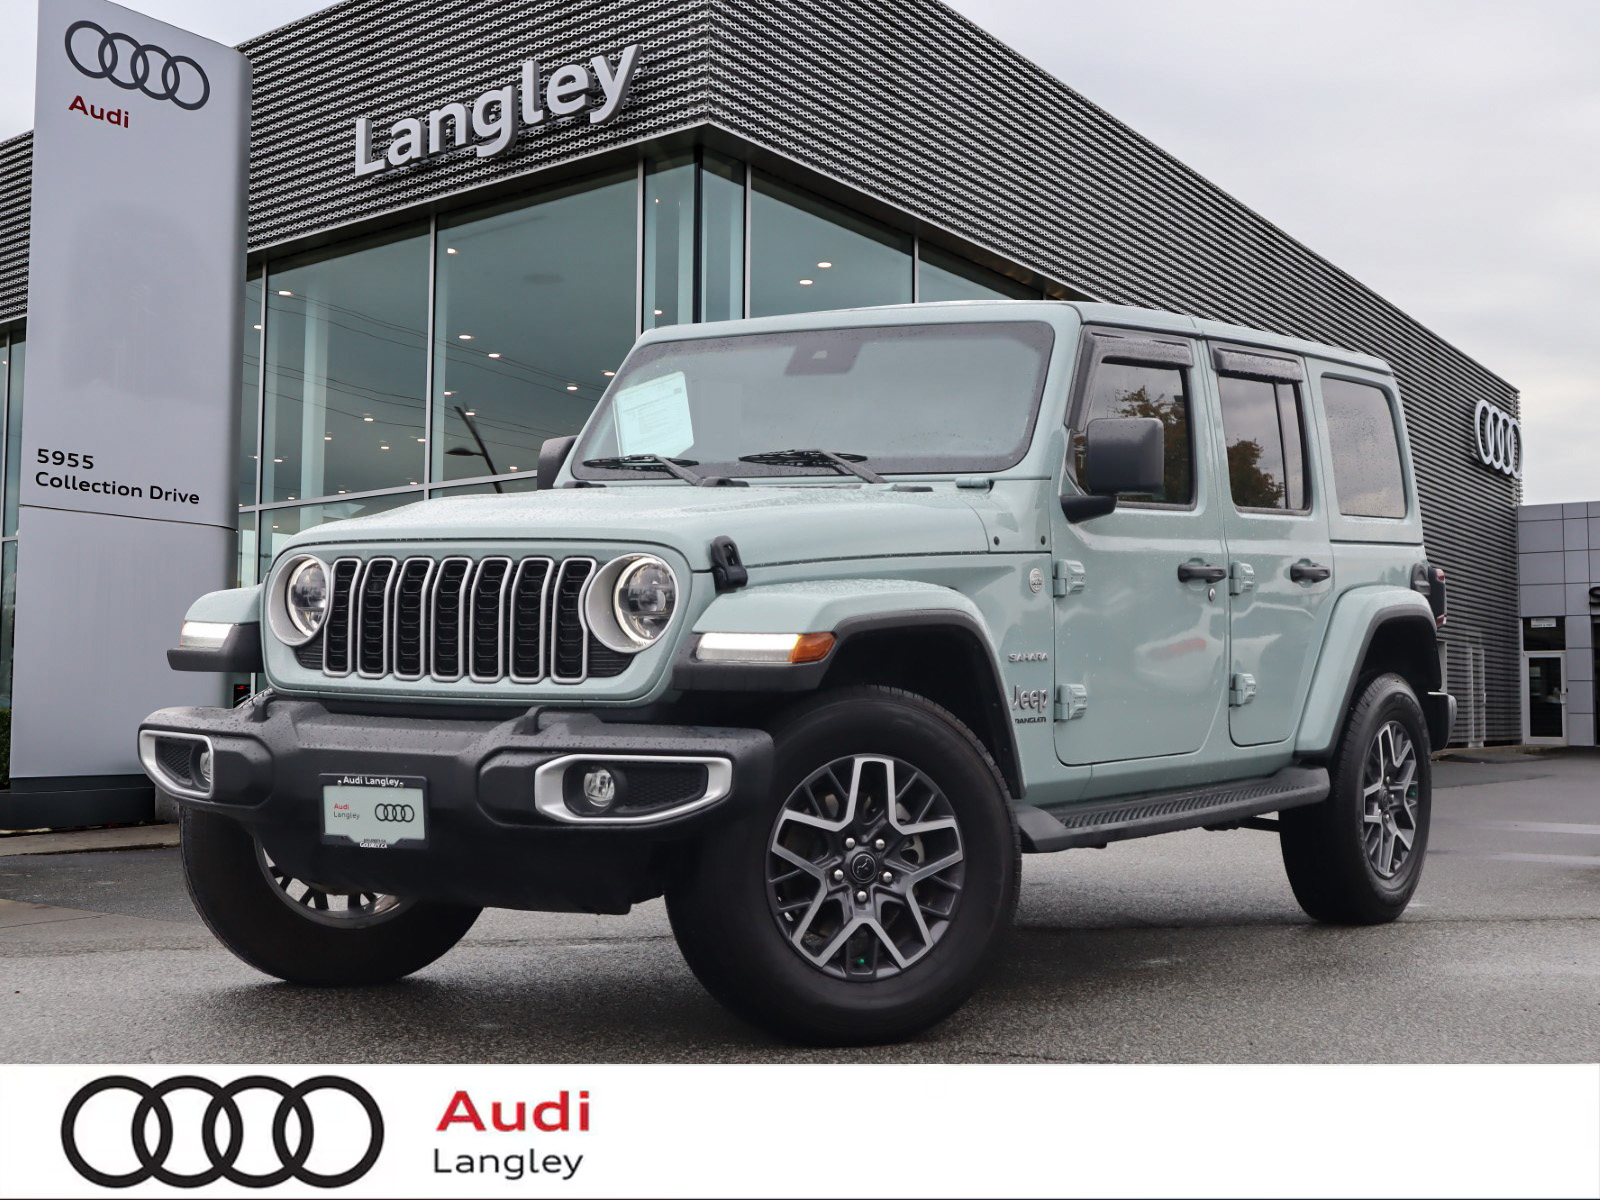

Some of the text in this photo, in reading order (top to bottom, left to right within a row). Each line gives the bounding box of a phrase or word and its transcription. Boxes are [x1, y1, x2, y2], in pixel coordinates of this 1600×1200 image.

[68, 95, 129, 128] Audi
[354, 43, 643, 177] Langley
[37, 448, 94, 470] 5955
[35, 471, 200, 505] Collection Drive
[1008, 652, 1048, 663] SAHARA
[1012, 685, 1048, 714] Jeep
[1014, 716, 1047, 725] RANGLER
[343, 776, 400, 787] Audi Langley
[333, 811, 360, 820] Langley
